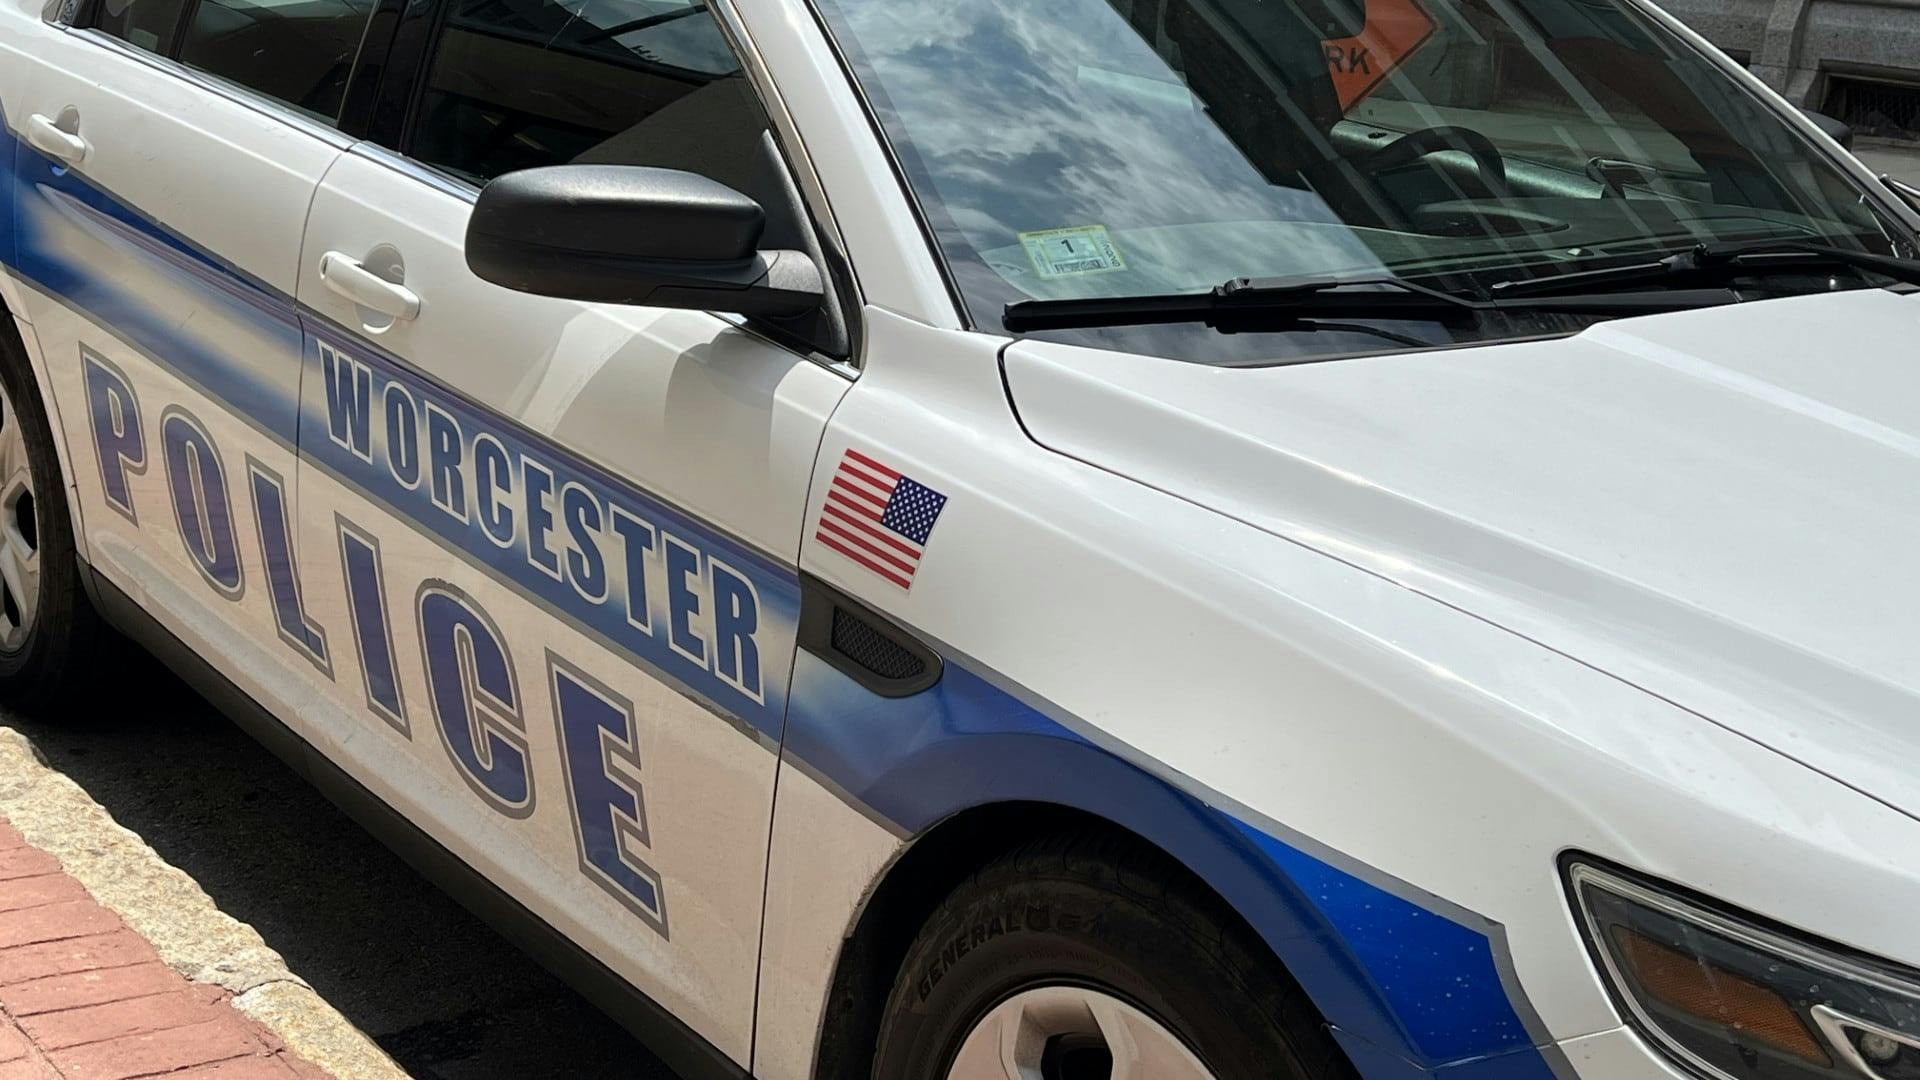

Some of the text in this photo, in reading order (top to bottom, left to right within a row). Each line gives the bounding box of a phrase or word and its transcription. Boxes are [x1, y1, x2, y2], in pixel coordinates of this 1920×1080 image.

[1060, 238, 1075, 254] 1
[316, 338, 764, 706] WORCESTER
[79, 341, 669, 941] POLICE
[918, 912, 1022, 1002] GENERAL
